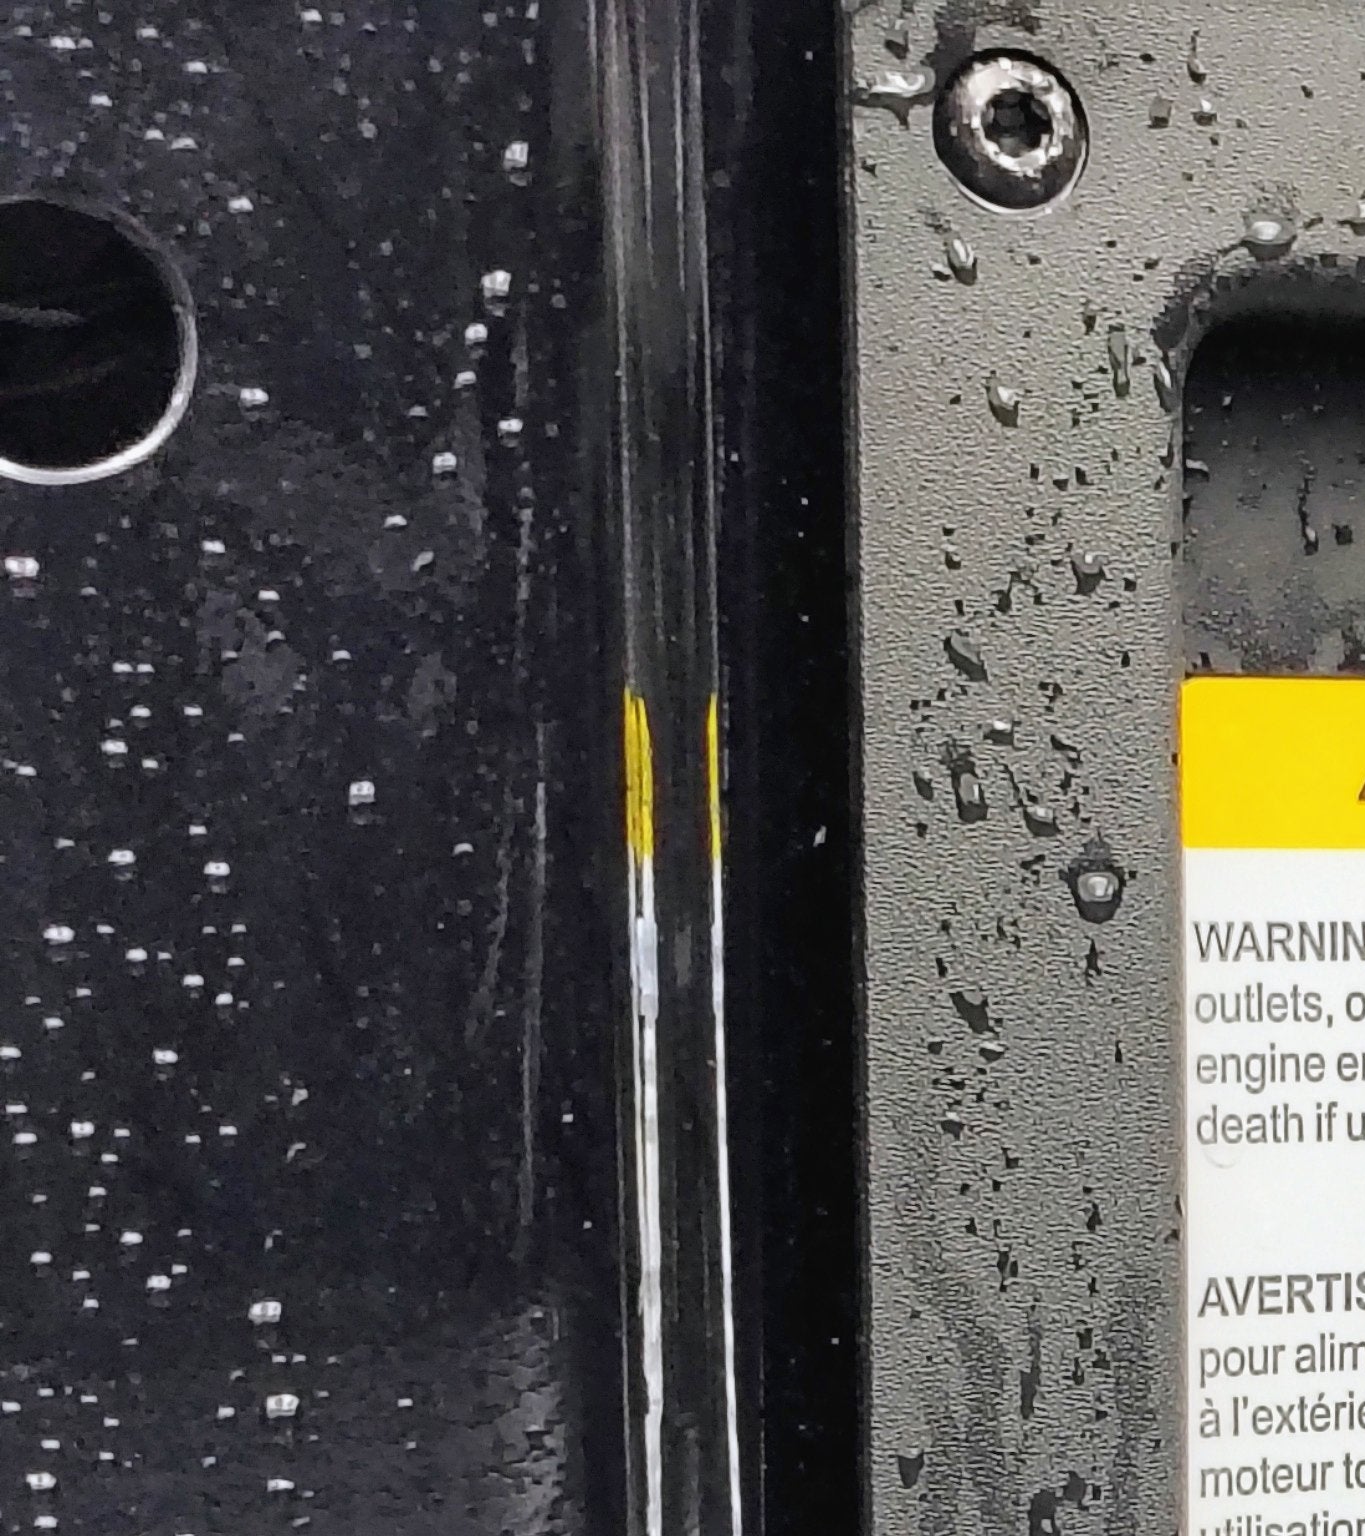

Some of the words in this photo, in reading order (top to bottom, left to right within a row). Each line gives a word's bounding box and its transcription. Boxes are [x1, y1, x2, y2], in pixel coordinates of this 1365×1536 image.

[1195, 982, 1333, 1028] outlets,
[1197, 1043, 1325, 1094] engine
[1197, 1103, 1304, 1145] death
[1316, 1101, 1338, 1142] if
[1200, 1345, 1285, 1388] pour
[1200, 1398, 1220, 1438] à
[1201, 1457, 1334, 1498] moteur
